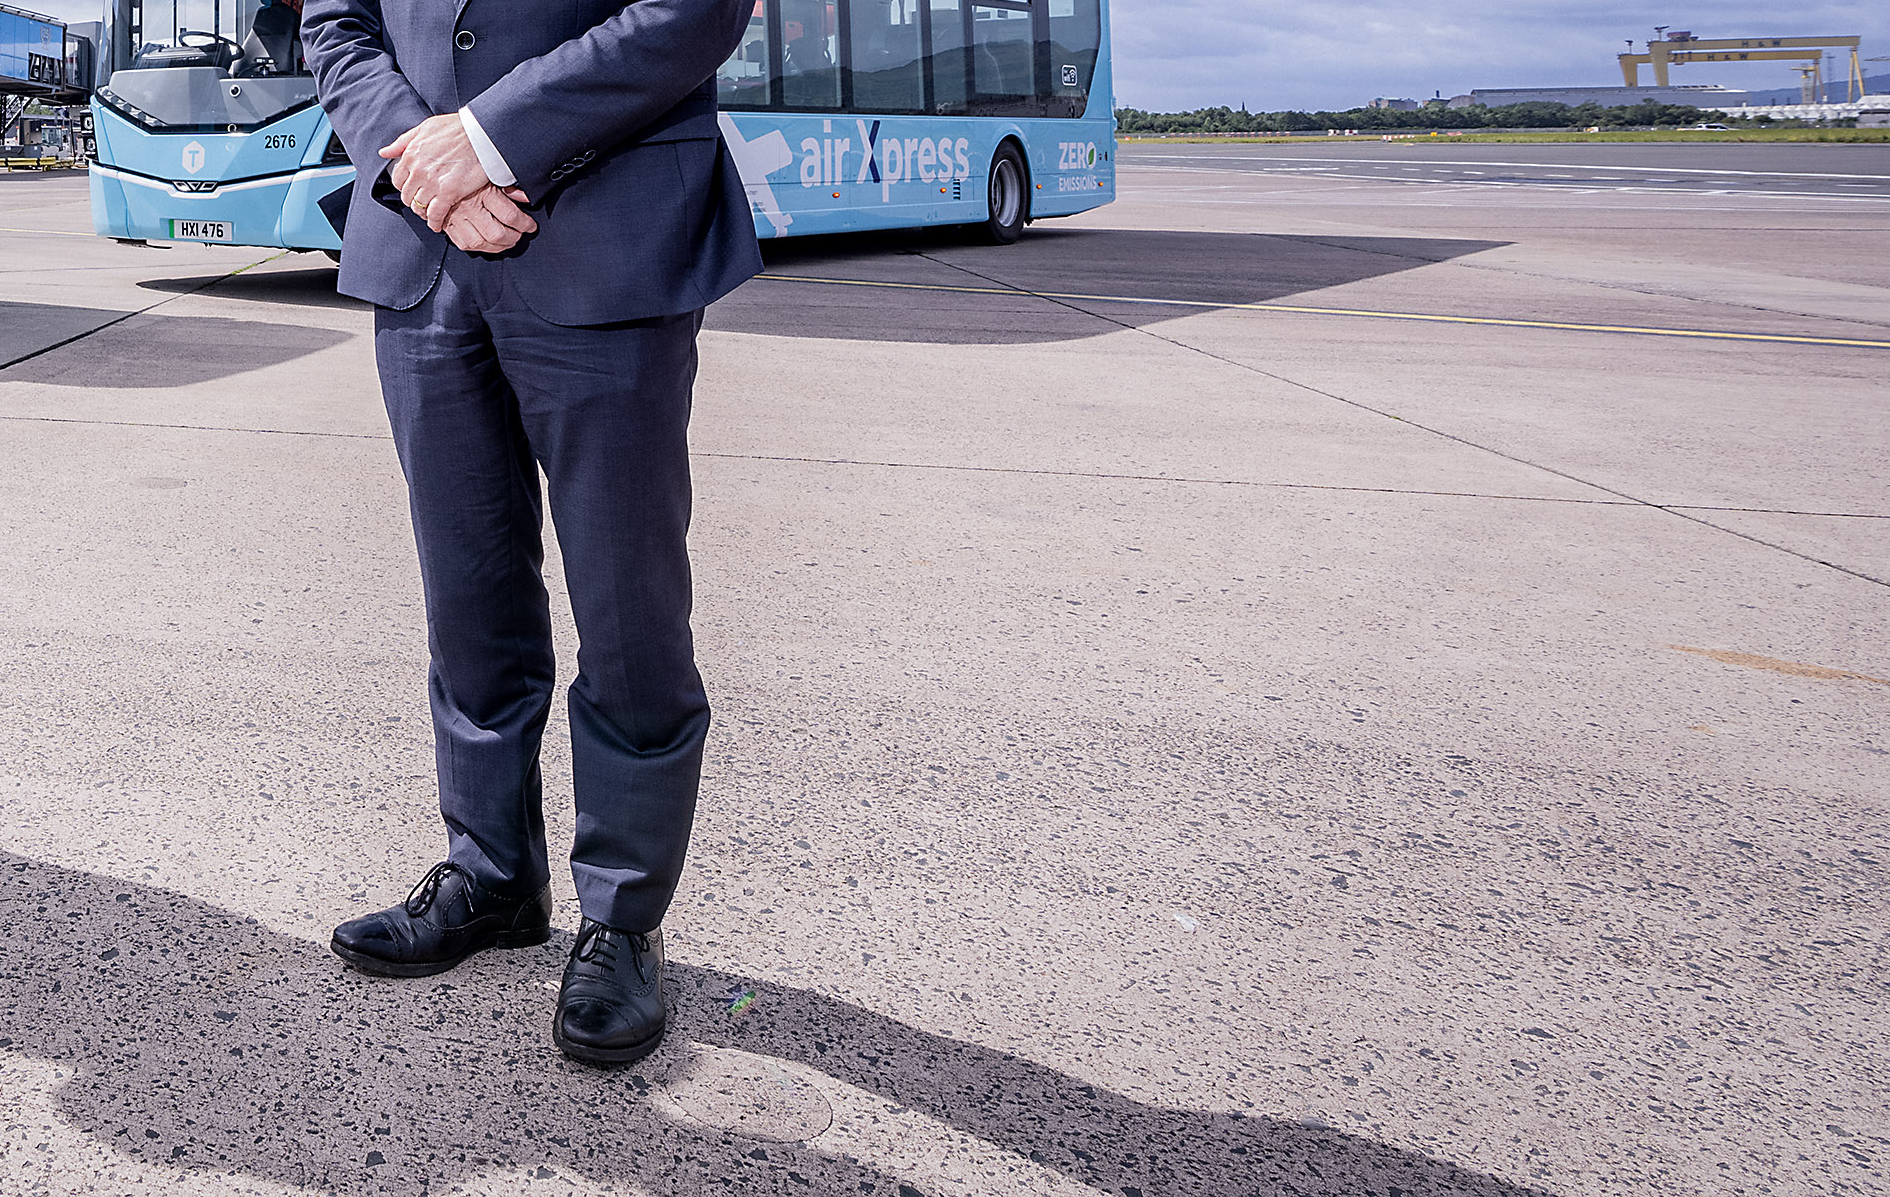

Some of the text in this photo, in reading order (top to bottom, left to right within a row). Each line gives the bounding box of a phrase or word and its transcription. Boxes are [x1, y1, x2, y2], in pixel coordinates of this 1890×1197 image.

[264, 134, 296, 149] 2676
[799, 119, 970, 203] air Xpress
[1058, 141, 1097, 170] ZERO
[1058, 175, 1097, 192] EMISSIONS
[181, 222, 224, 238] HXI 476
